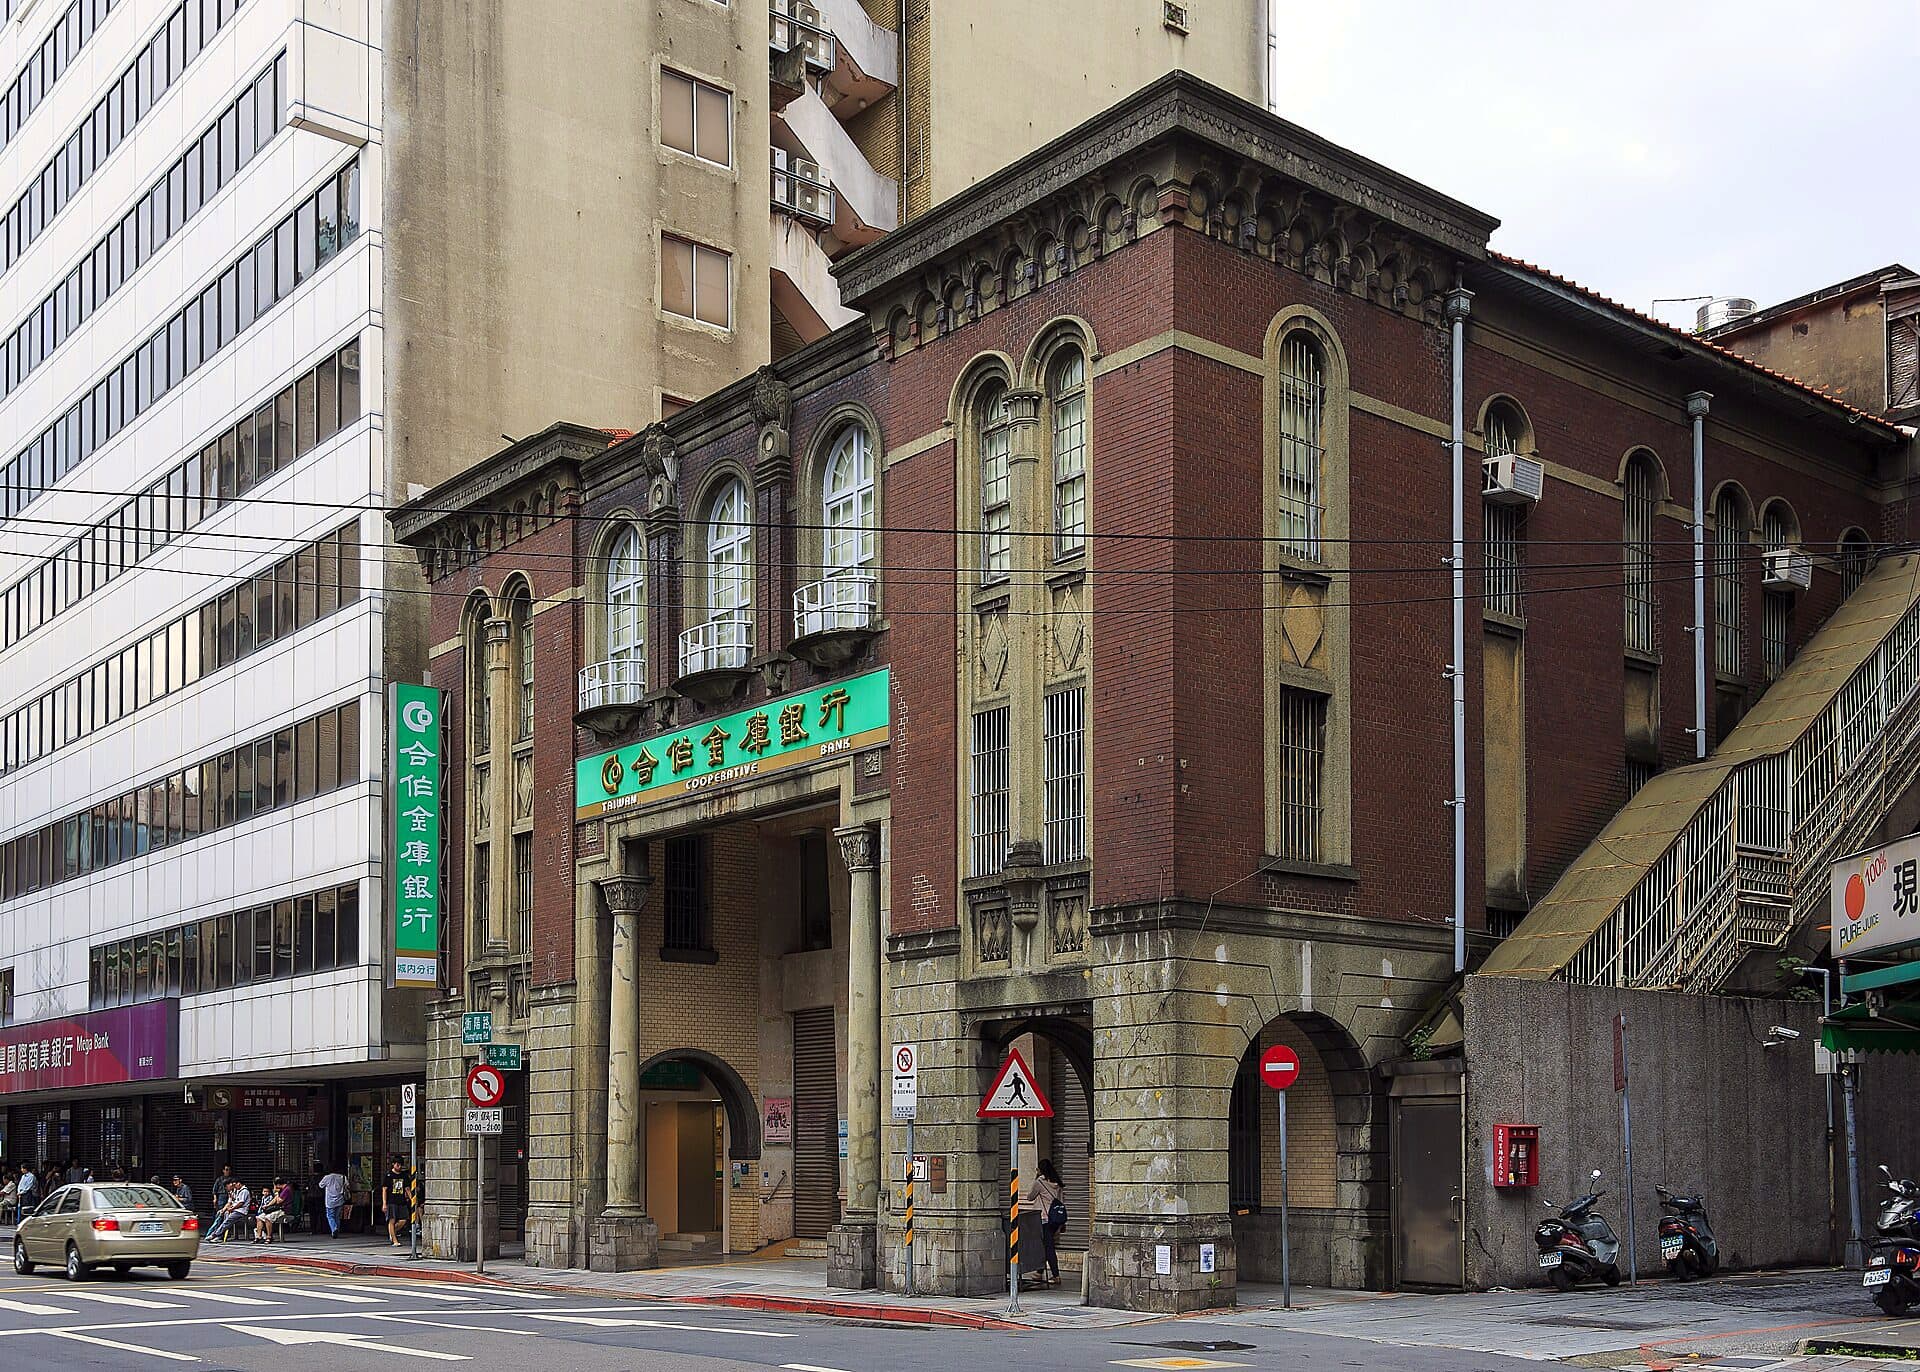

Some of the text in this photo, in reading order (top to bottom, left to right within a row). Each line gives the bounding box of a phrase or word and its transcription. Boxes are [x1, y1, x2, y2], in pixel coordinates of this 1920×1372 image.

[631, 688, 852, 785] 合作金庫銀行
[602, 737, 851, 812] TAIWAN COOPERATIVE BANK
[400, 741, 436, 933] 合作金庫銀行
[1865, 850, 1888, 886] 100%
[1893, 859, 1919, 918] 現
[1840, 914, 1880, 949] PURE JUICE
[76, 1031, 110, 1055] Mega Bank
